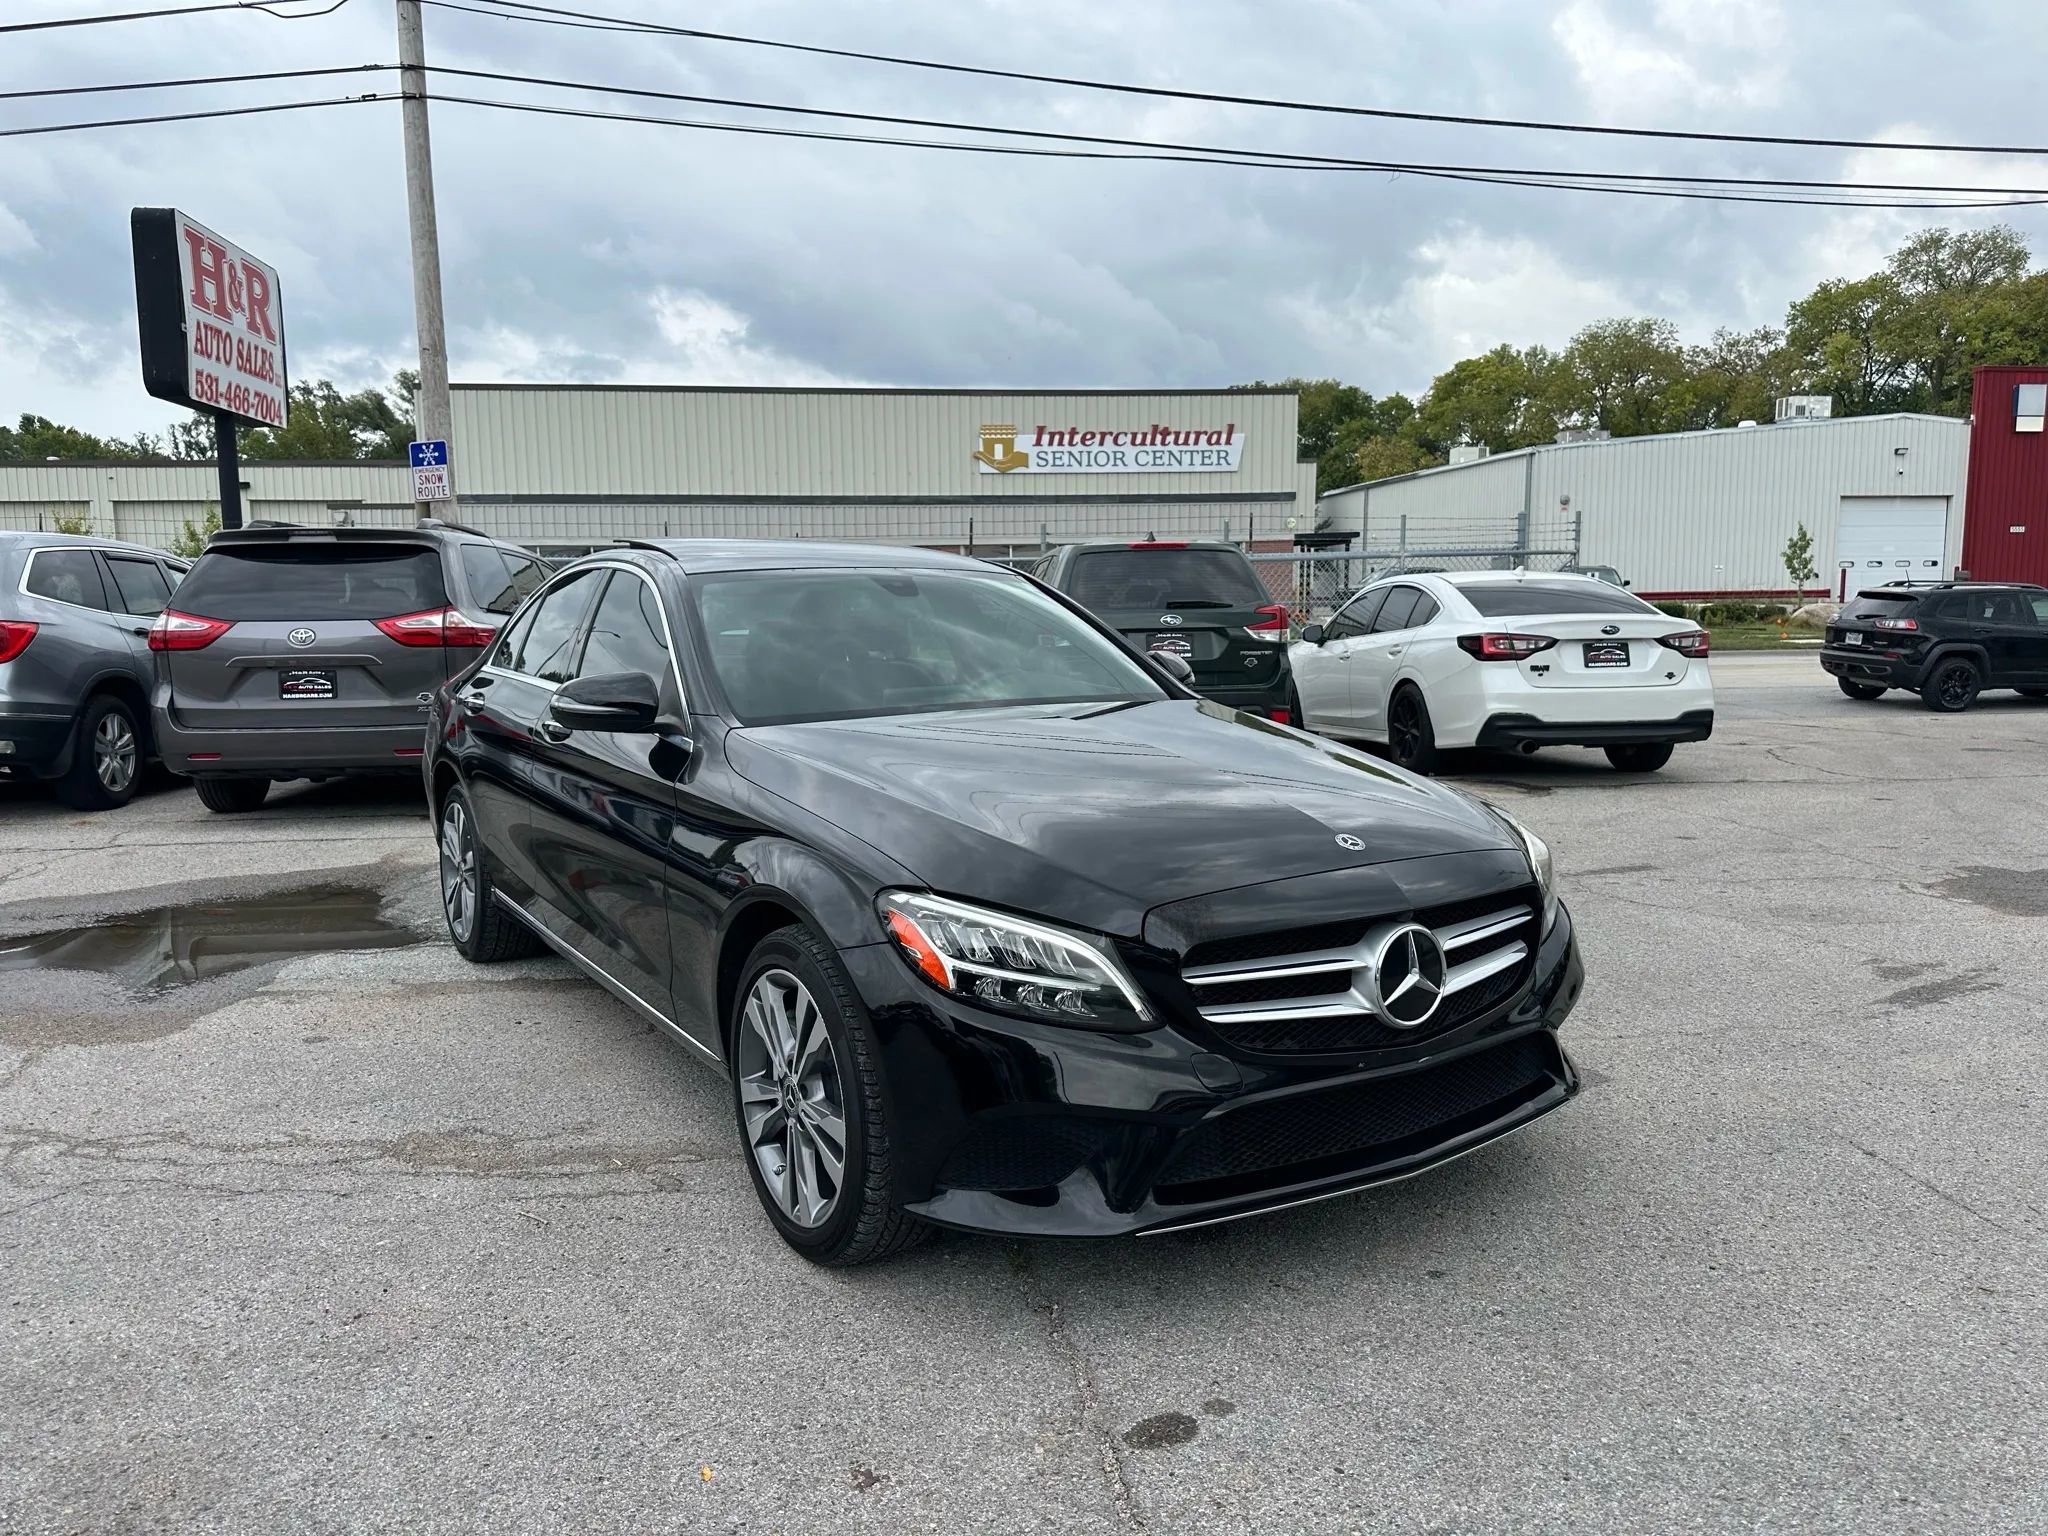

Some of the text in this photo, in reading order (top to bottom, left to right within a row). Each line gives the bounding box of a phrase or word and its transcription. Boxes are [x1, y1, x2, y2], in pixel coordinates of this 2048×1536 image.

[183, 223, 276, 345] H&R
[194, 319, 275, 383] AUTO SALES
[194, 368, 282, 425] 531-466-7004
[1032, 424, 1235, 447] Intercultural
[1036, 449, 1232, 468] SENIOR CENTER
[418, 474, 444, 486] SNOW
[418, 485, 448, 498] ROUTE
